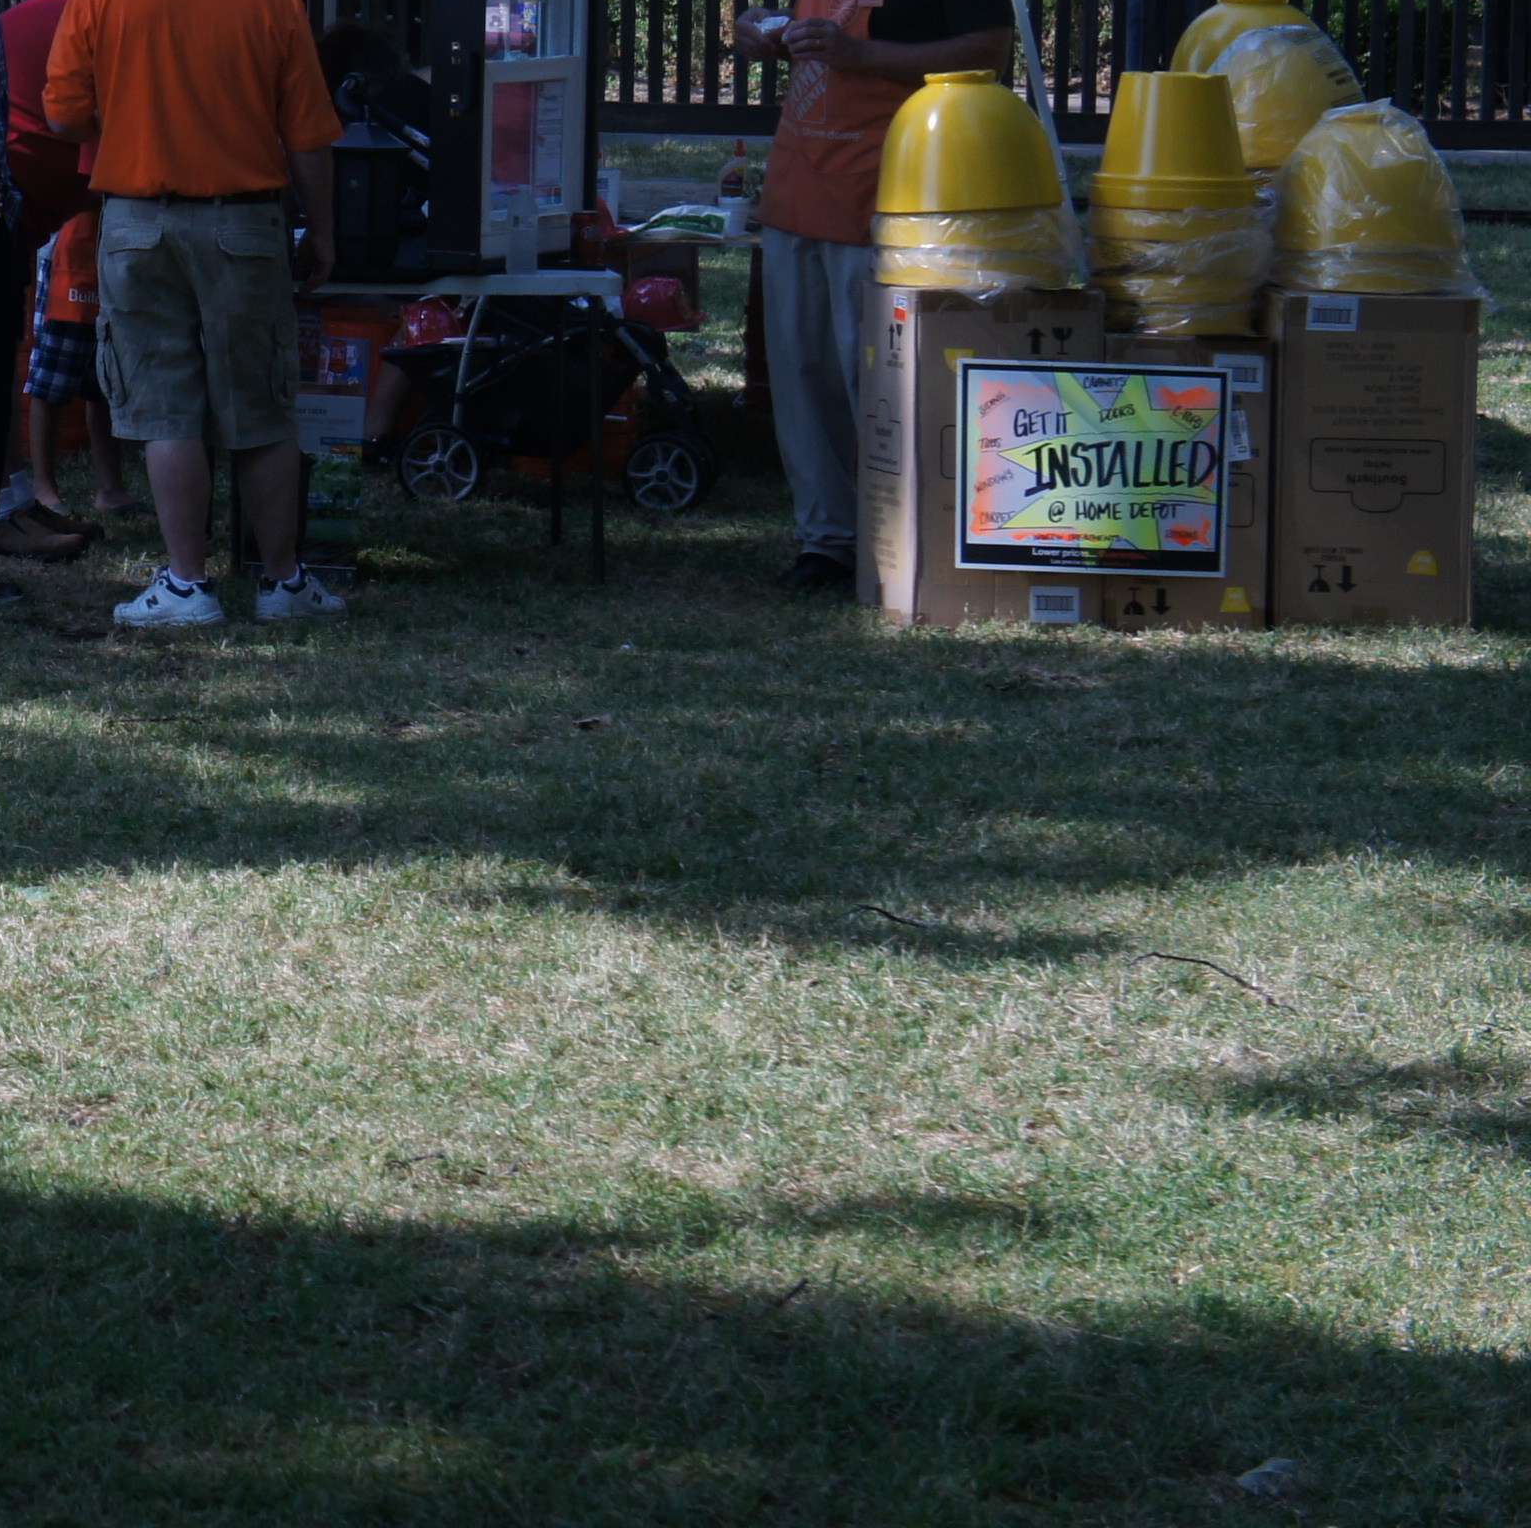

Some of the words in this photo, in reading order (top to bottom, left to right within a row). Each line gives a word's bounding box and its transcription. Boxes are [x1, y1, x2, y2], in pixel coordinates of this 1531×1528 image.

[1013, 408, 1056, 438] GET
[1055, 410, 1075, 434] IT
[1022, 438, 1220, 498] INSTALLED
[1075, 501, 1123, 521] HOME
[1129, 501, 1187, 521] DEPOT
